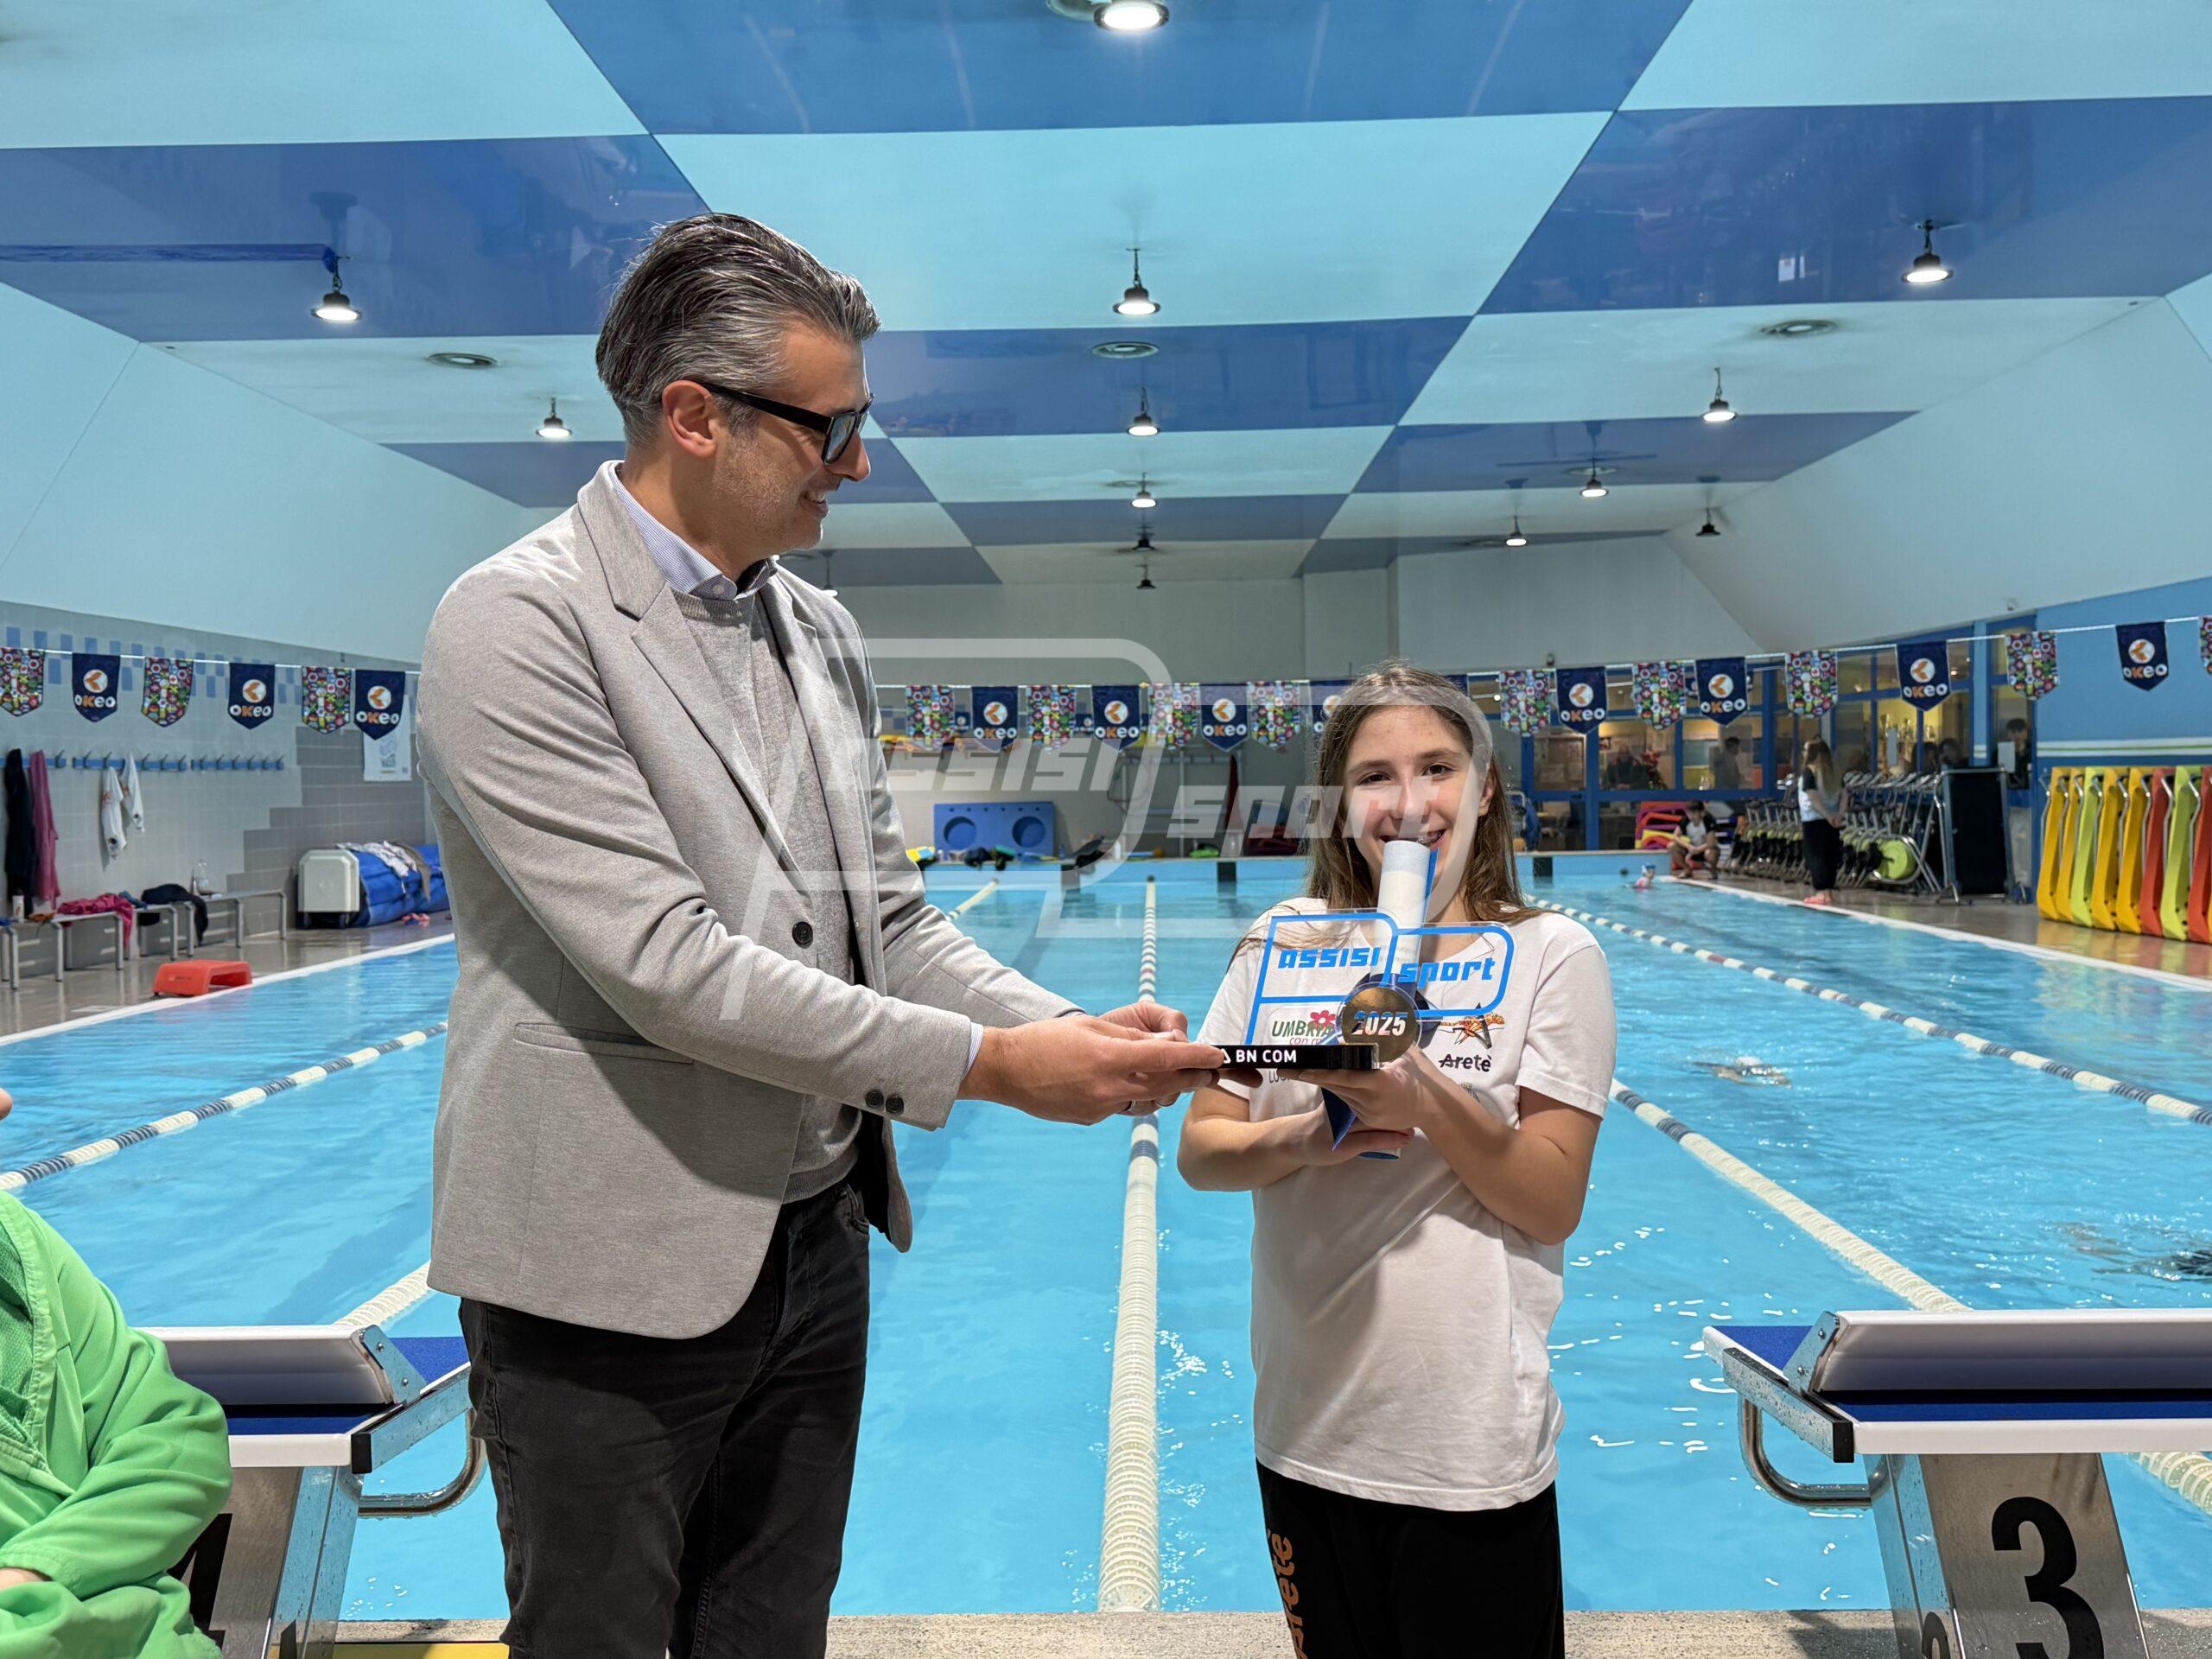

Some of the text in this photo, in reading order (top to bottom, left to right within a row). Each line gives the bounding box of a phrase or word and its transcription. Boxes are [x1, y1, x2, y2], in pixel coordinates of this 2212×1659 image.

[1278, 947, 1382, 969] assisi
[1397, 957, 1497, 988] sport
[1351, 1010, 1408, 1037] 2025
[1236, 1049, 1297, 1063] BN COM
[1991, 1496, 2105, 1659] 3
